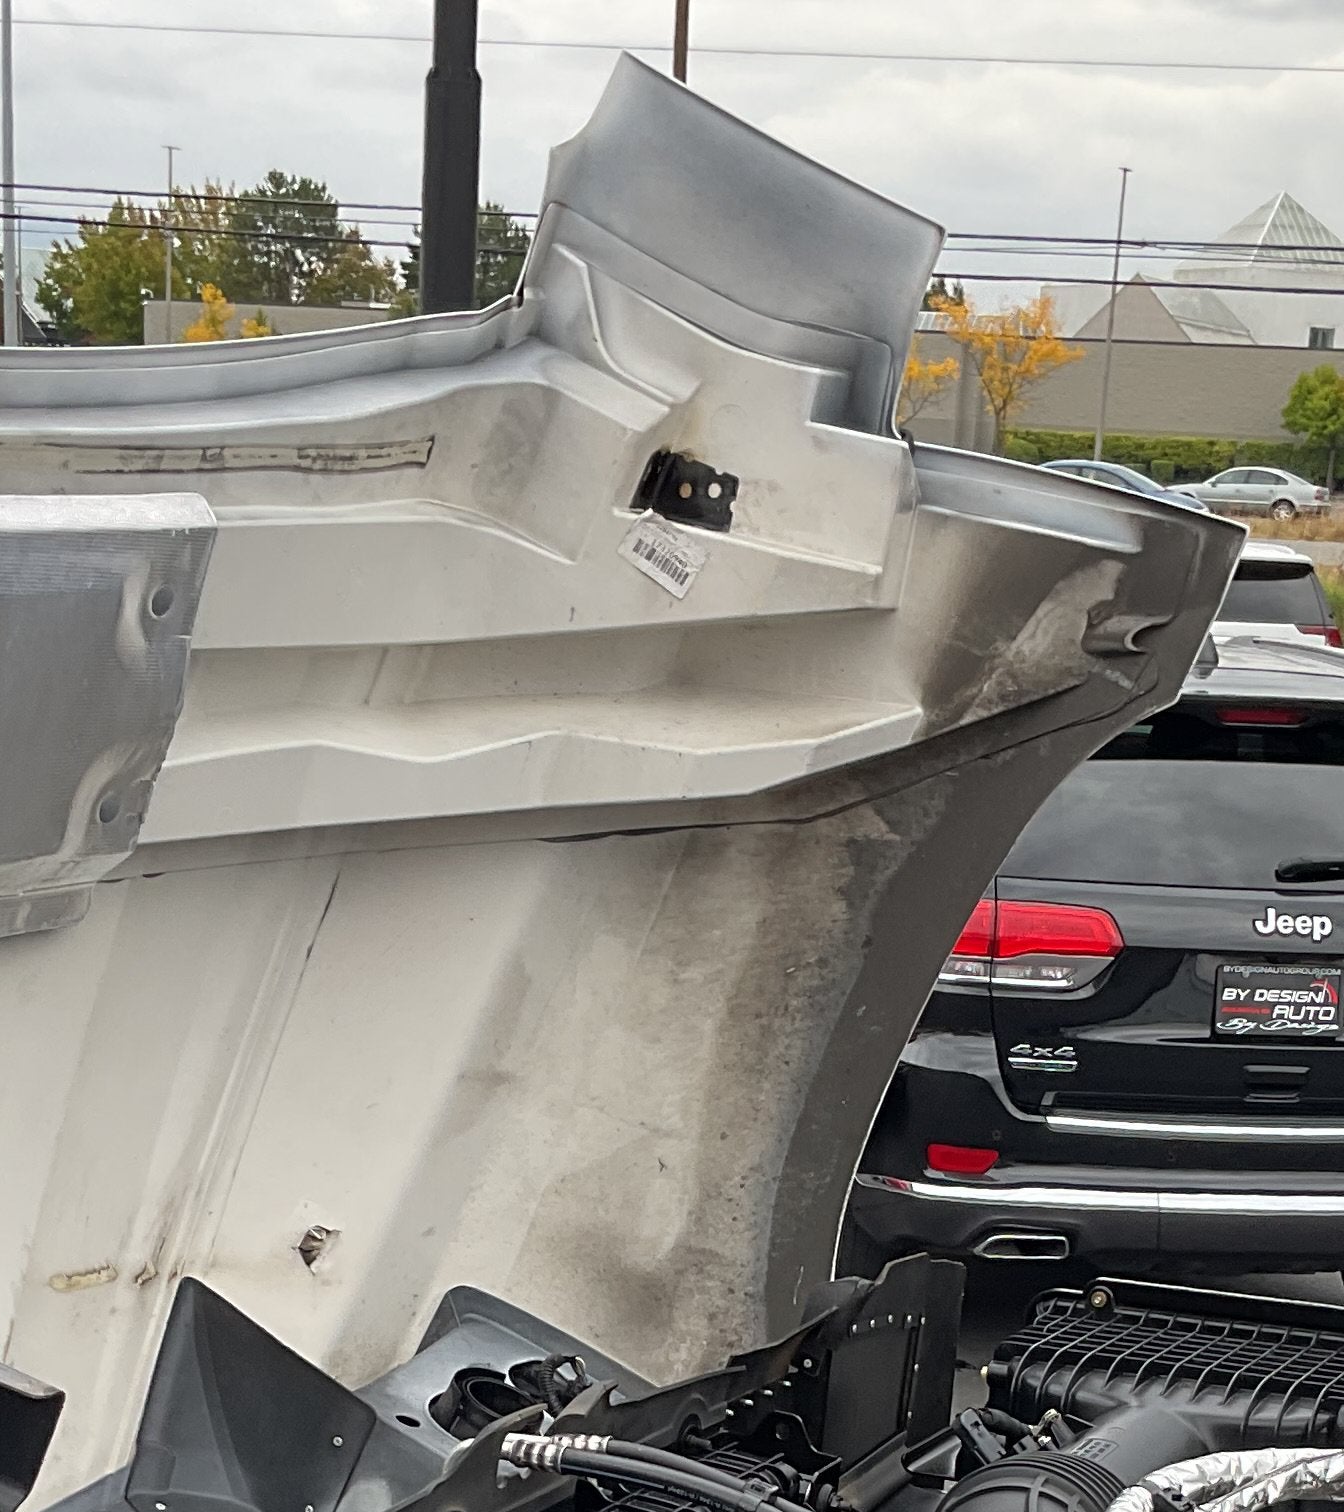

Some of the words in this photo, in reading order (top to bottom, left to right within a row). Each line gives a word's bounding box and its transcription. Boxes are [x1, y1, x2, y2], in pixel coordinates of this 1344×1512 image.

[1254, 906, 1333, 942] Jeep
[1222, 987, 1251, 1002] BY
[1253, 988, 1325, 1004] DESIGN
[1272, 1004, 1336, 1021] AUTO
[1216, 1017, 1258, 1035] By
[1259, 1018, 1340, 1036] Design
